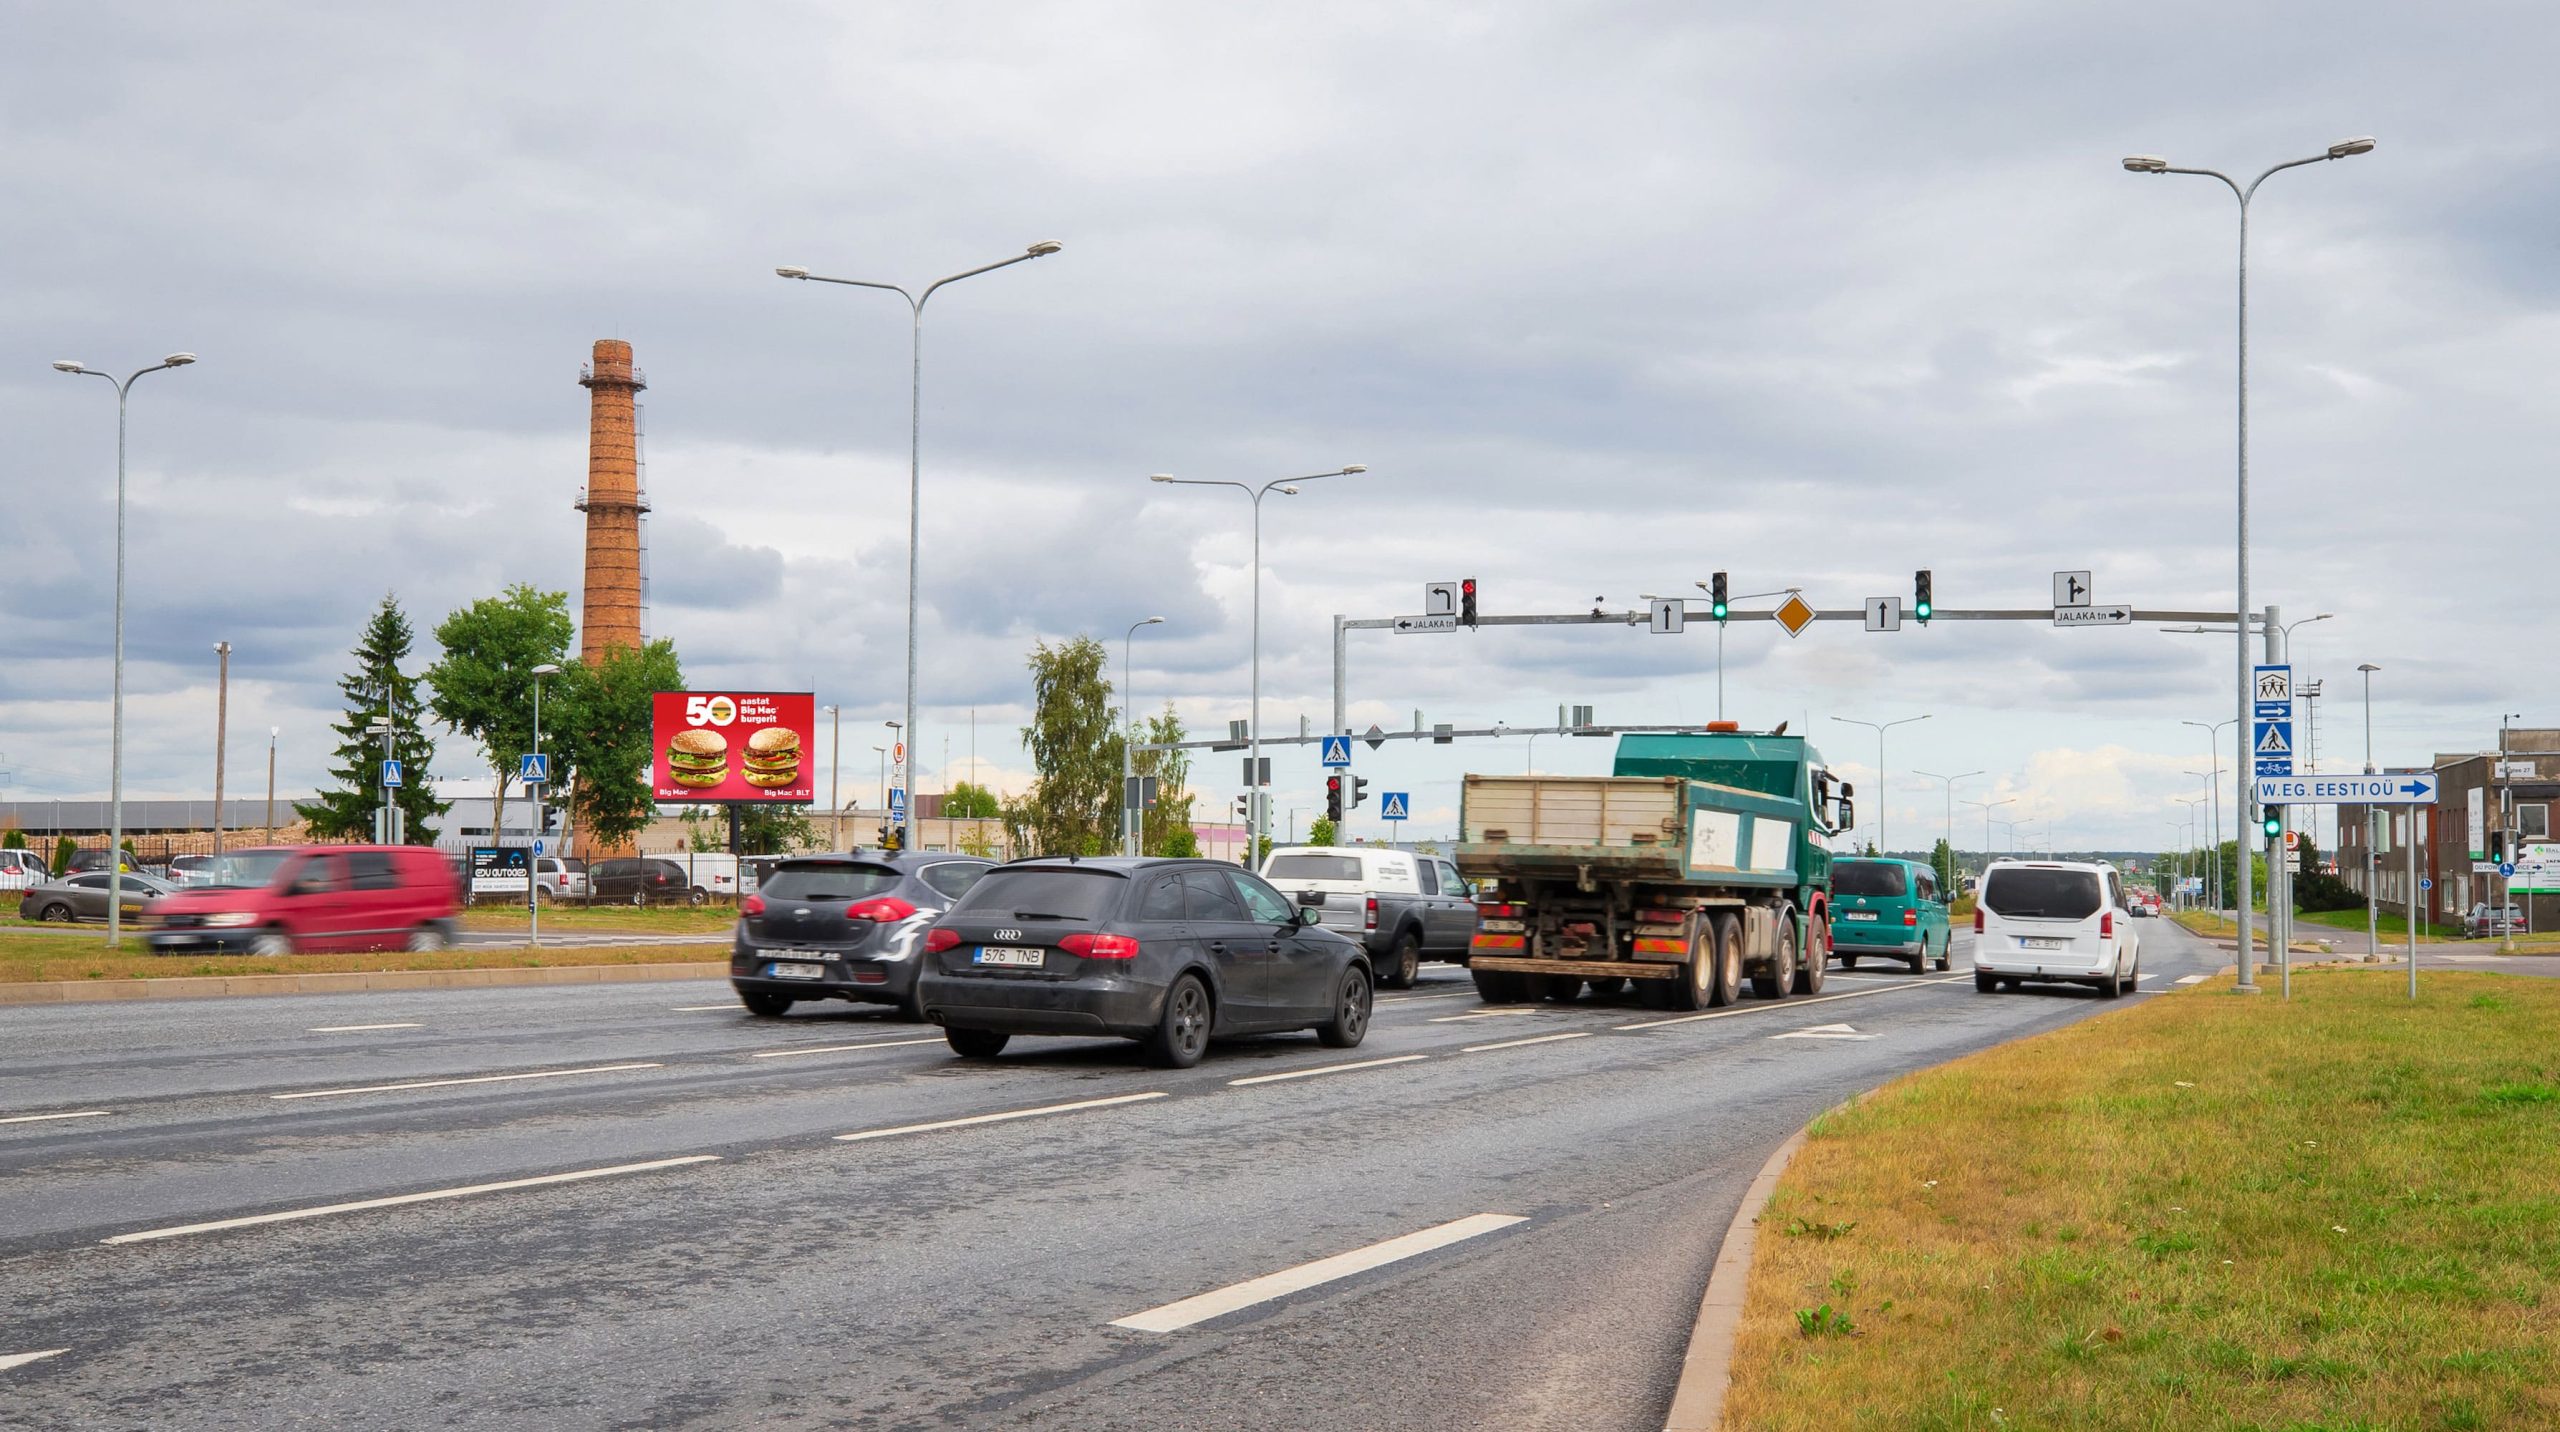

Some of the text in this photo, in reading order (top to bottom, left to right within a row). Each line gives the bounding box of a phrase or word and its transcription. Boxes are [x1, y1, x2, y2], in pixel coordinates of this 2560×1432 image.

[2057, 612, 2107, 621] JALAKA tn
[1413, 620, 1454, 629] JALAKA tn
[740, 697, 770, 705] aastat
[685, 695, 737, 727] 50
[740, 705, 777, 714] Big Mac
[740, 714, 777, 724] burgerit
[659, 788, 689, 796] Big Mac
[2262, 779, 2394, 797] W.EG. EESTI OÜ
[764, 789, 777, 797] Big
[984, 949, 1040, 963] 576 TNB
